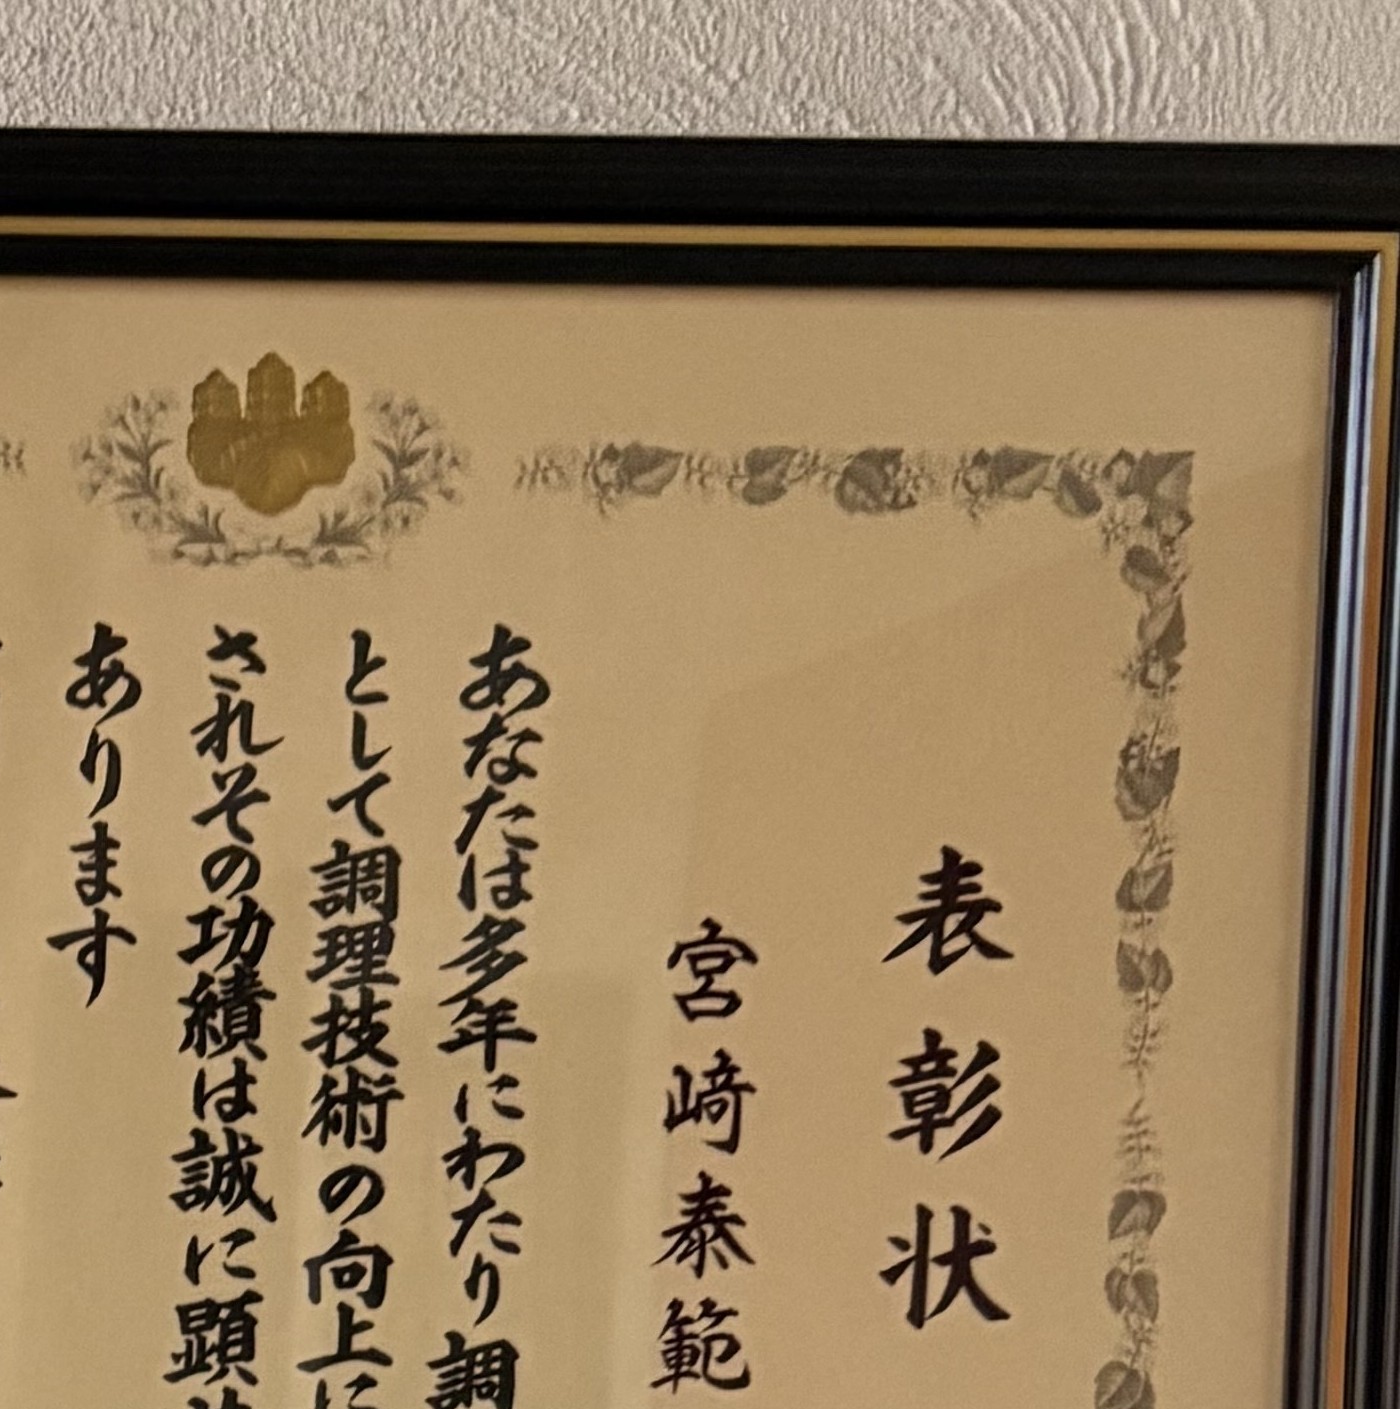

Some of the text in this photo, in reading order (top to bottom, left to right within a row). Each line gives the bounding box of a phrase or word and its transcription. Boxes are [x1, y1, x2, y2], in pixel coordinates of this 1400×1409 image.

[45, 620, 145, 1009] あります
[879, 844, 1015, 1330] 表彰状
